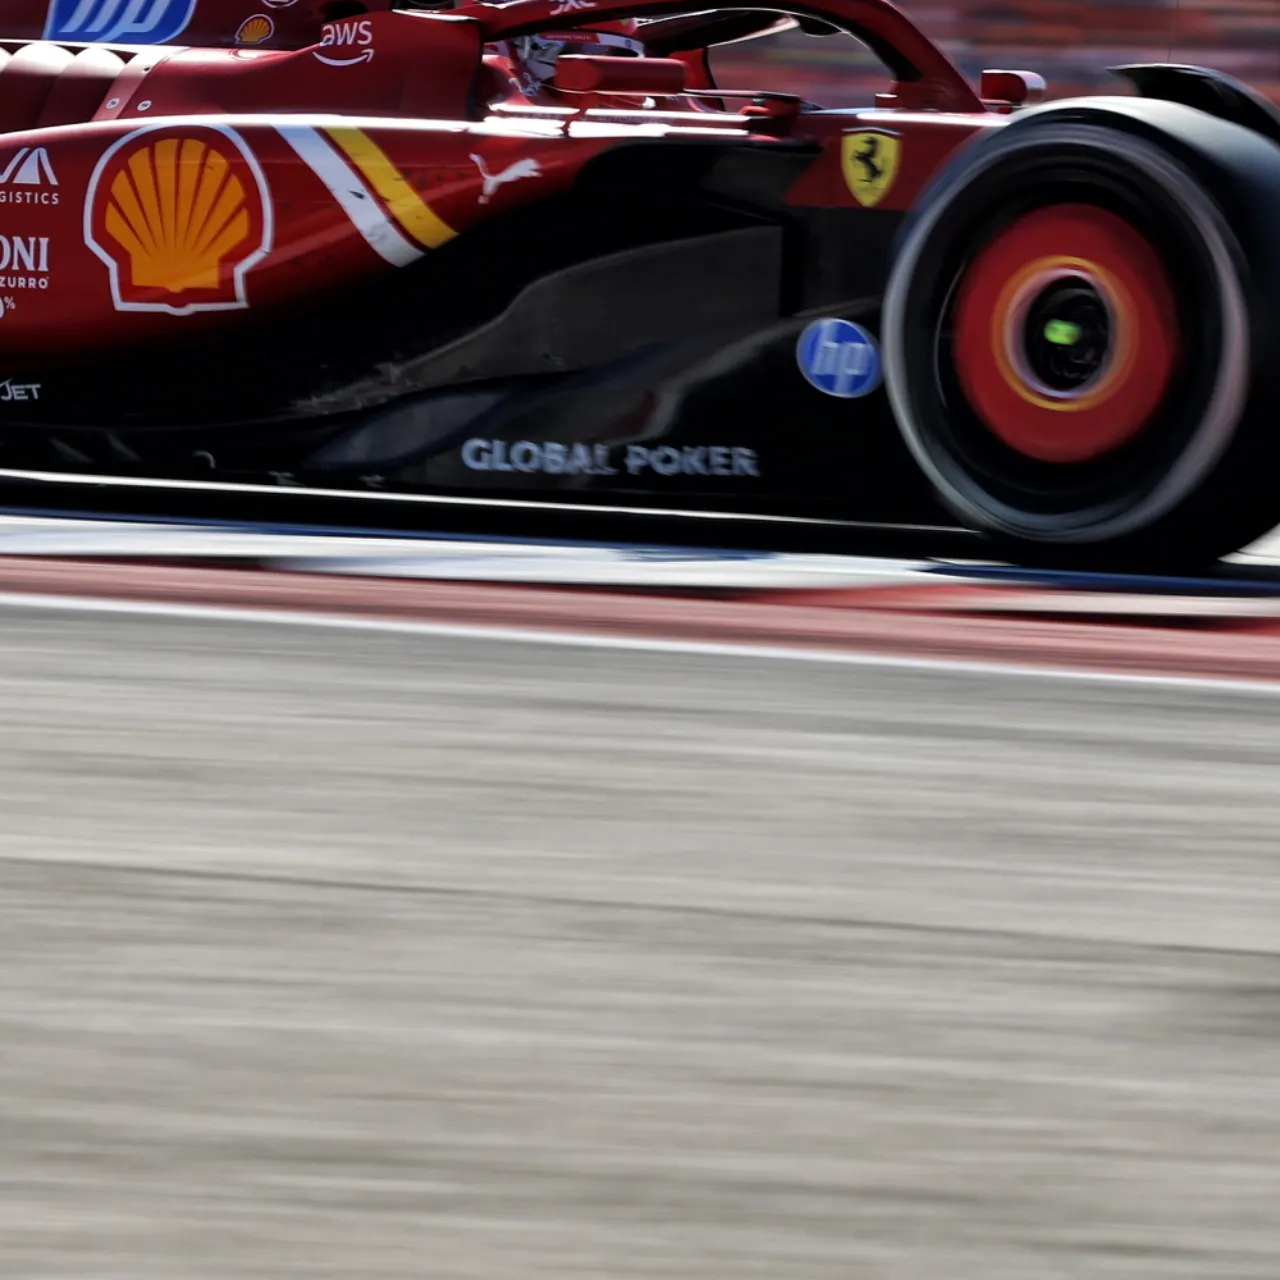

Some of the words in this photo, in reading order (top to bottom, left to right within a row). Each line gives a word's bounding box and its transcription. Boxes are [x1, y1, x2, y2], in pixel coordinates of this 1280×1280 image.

[322, 21, 373, 47] aws
[810, 319, 876, 395] hp
[461, 438, 619, 476] GLOBAL
[624, 443, 761, 477] POKER
